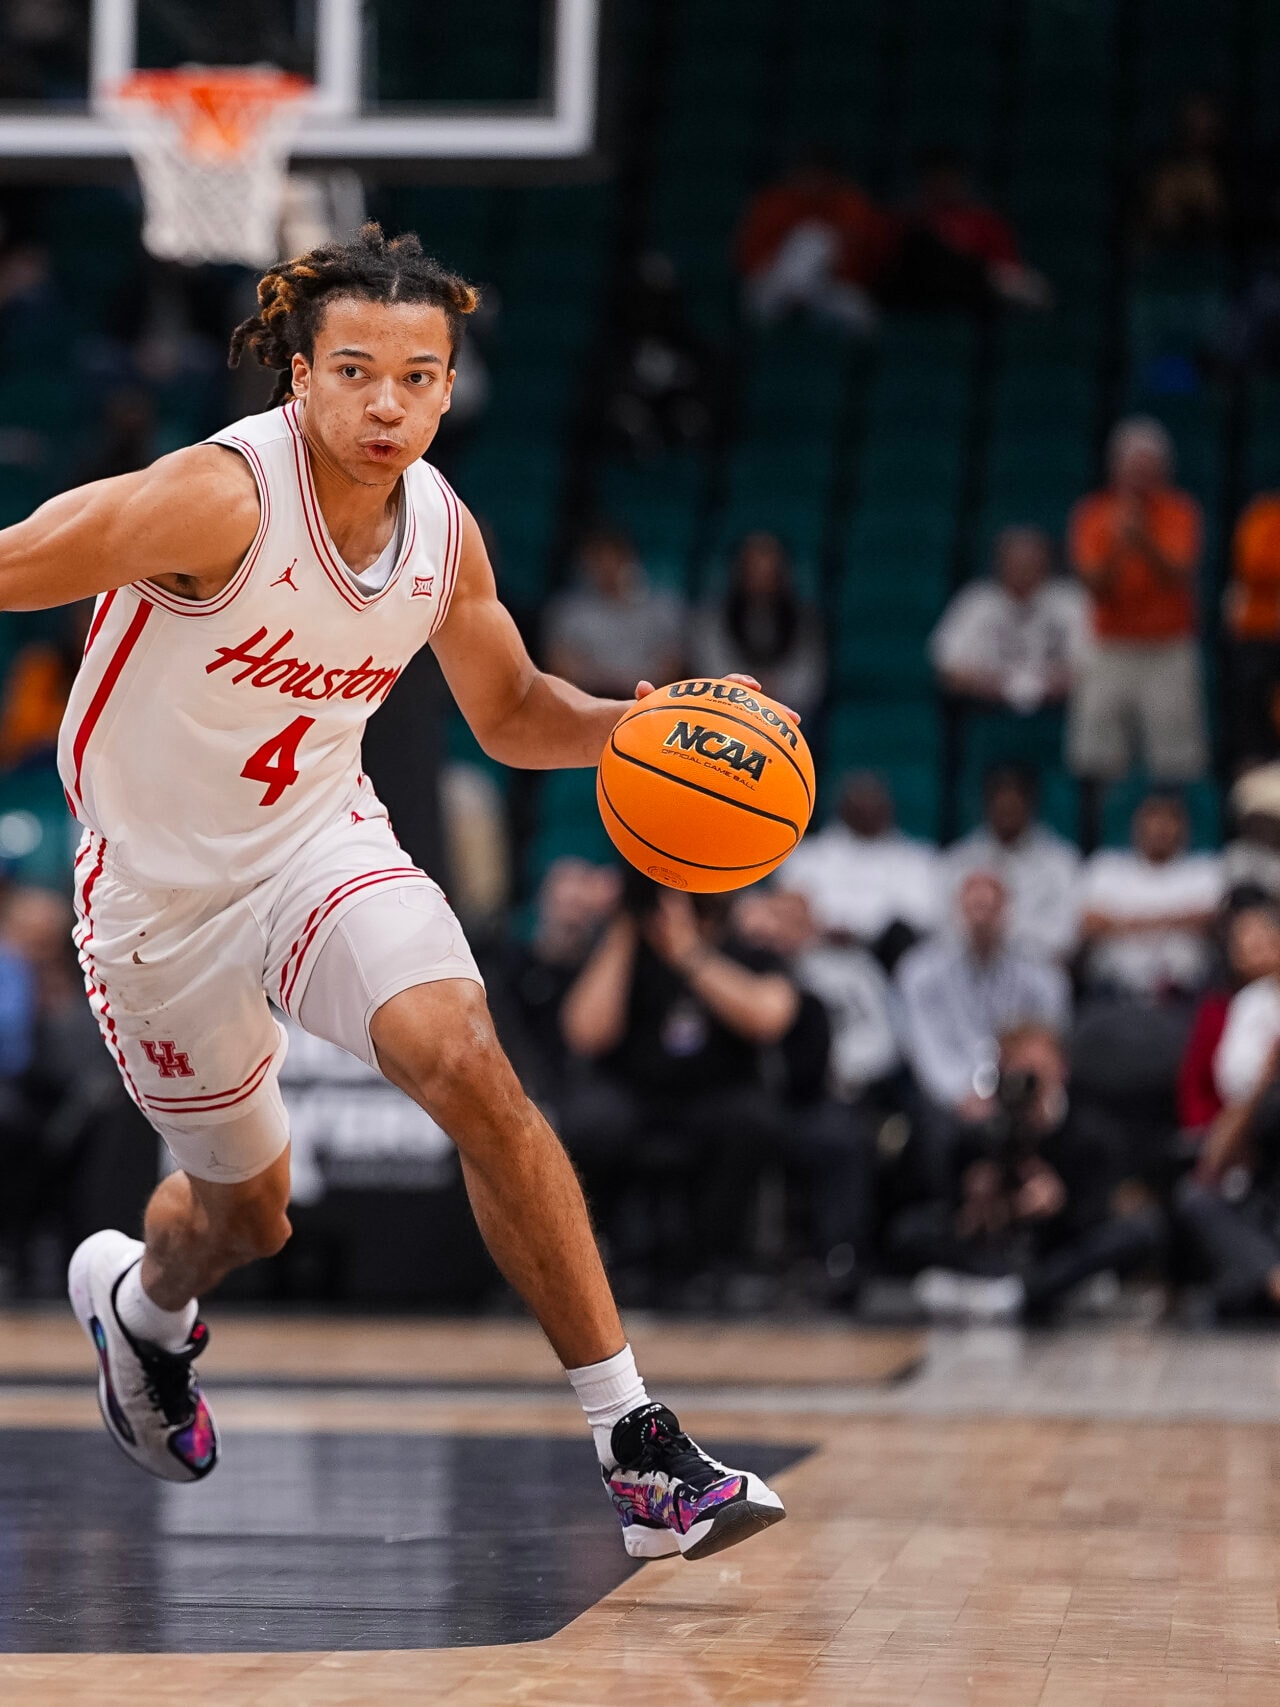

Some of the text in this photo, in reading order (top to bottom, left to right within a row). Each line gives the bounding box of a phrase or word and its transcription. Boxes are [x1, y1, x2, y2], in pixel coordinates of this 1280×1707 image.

[205, 626, 402, 703] Houston
[667, 681, 798, 751] Wilson
[239, 715, 316, 806] 4
[661, 748, 756, 792] OFFICIAL GAME BALL
[663, 720, 768, 783] NCAA
[140, 1040, 195, 1078] UH
